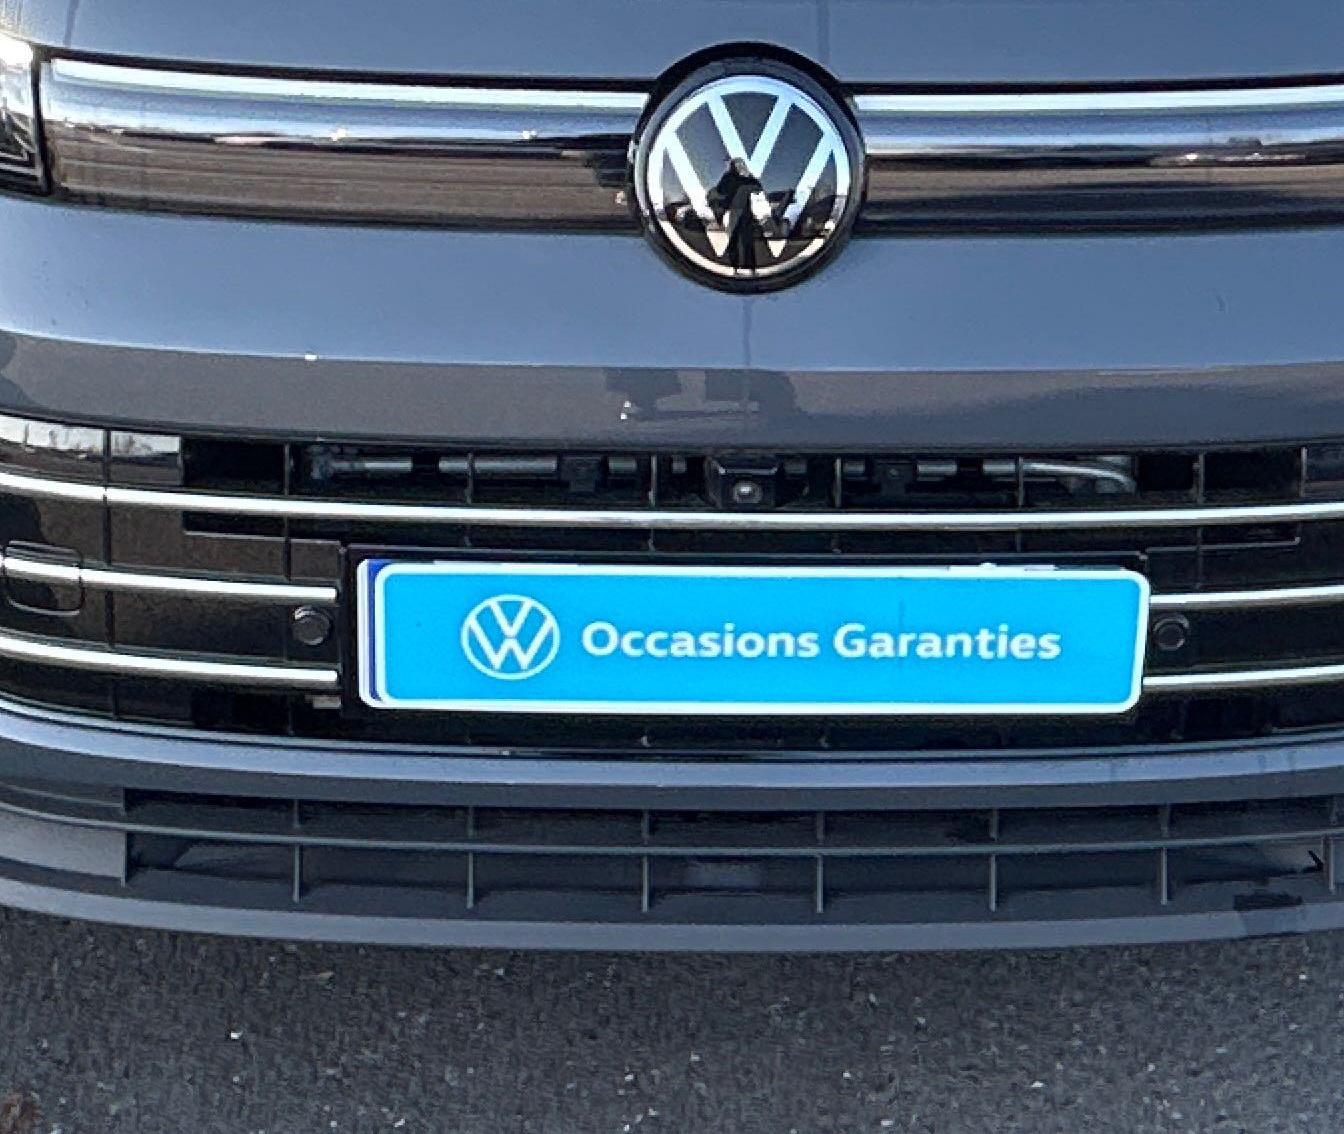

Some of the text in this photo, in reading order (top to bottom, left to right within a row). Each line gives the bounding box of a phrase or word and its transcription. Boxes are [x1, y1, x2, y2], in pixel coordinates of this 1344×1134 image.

[460, 594, 1062, 680] VW Occasions Garanties
